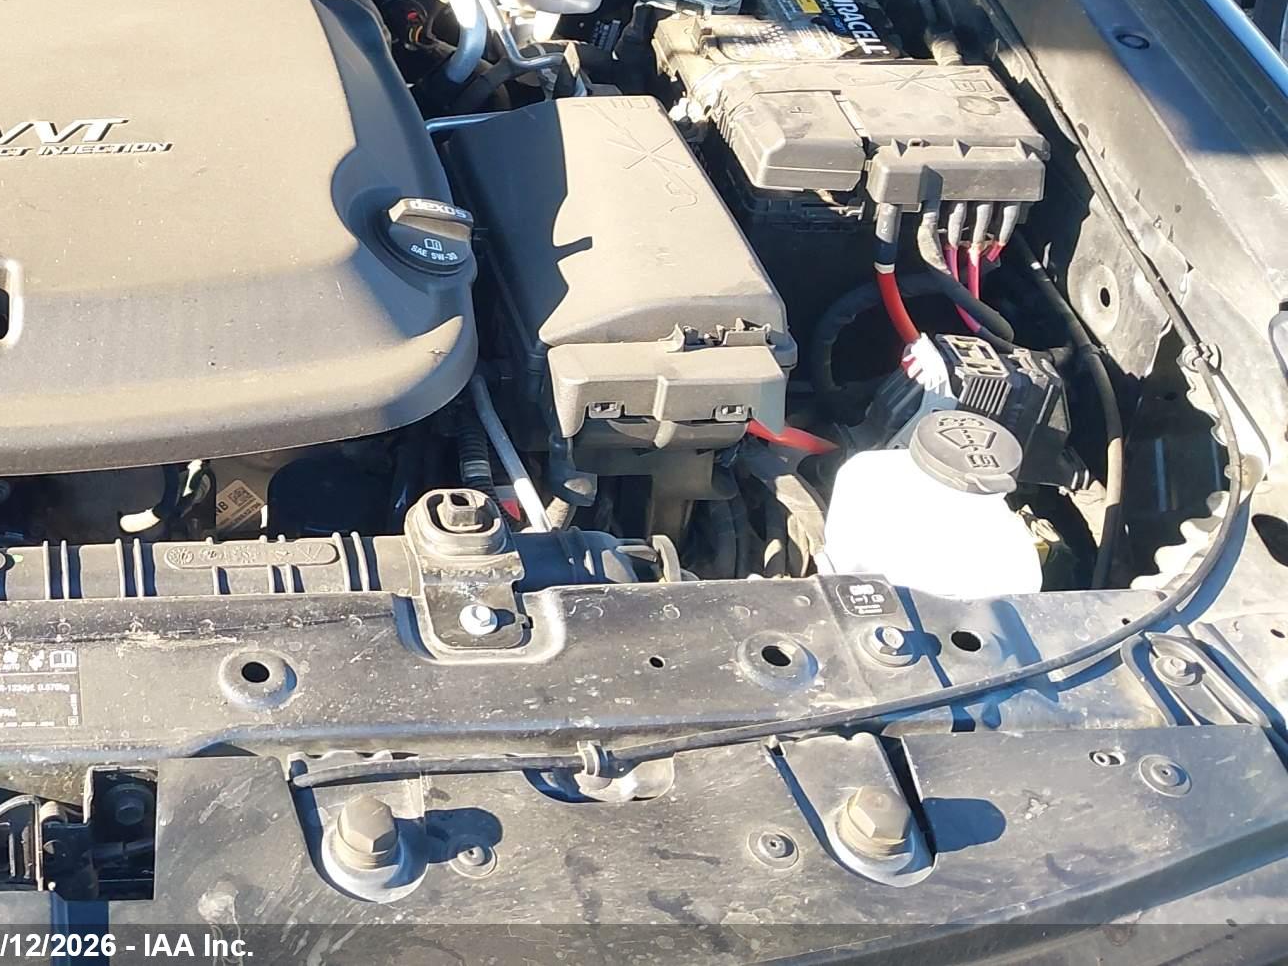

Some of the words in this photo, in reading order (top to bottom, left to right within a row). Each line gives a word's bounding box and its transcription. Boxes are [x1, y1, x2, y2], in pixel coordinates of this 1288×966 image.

[38, 142, 173, 155] INJECTION
[410, 199, 467, 218] dexos
[411, 245, 428, 257] SAE
